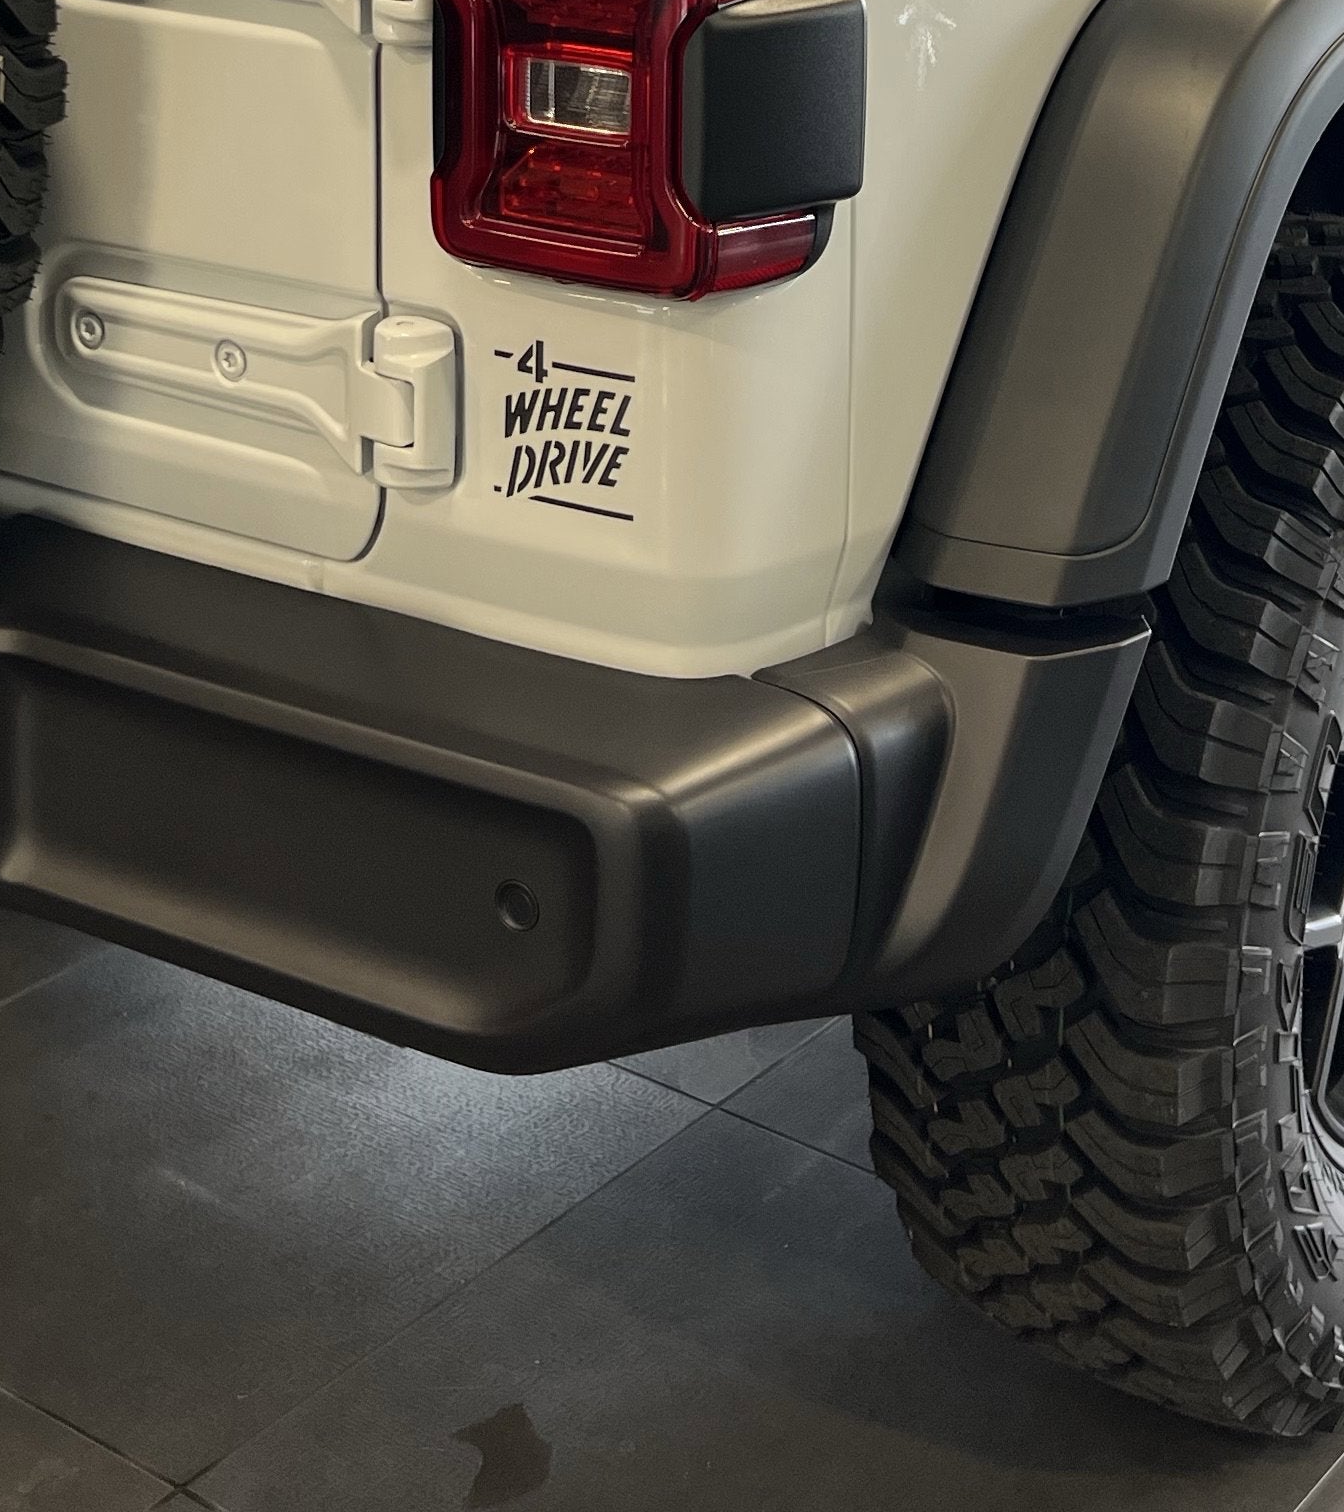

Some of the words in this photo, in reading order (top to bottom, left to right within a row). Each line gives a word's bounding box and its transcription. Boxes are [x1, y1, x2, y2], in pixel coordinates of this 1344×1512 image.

[517, 340, 549, 383] 4
[504, 387, 632, 439] WHEEL
[506, 440, 630, 498] DRIVE
